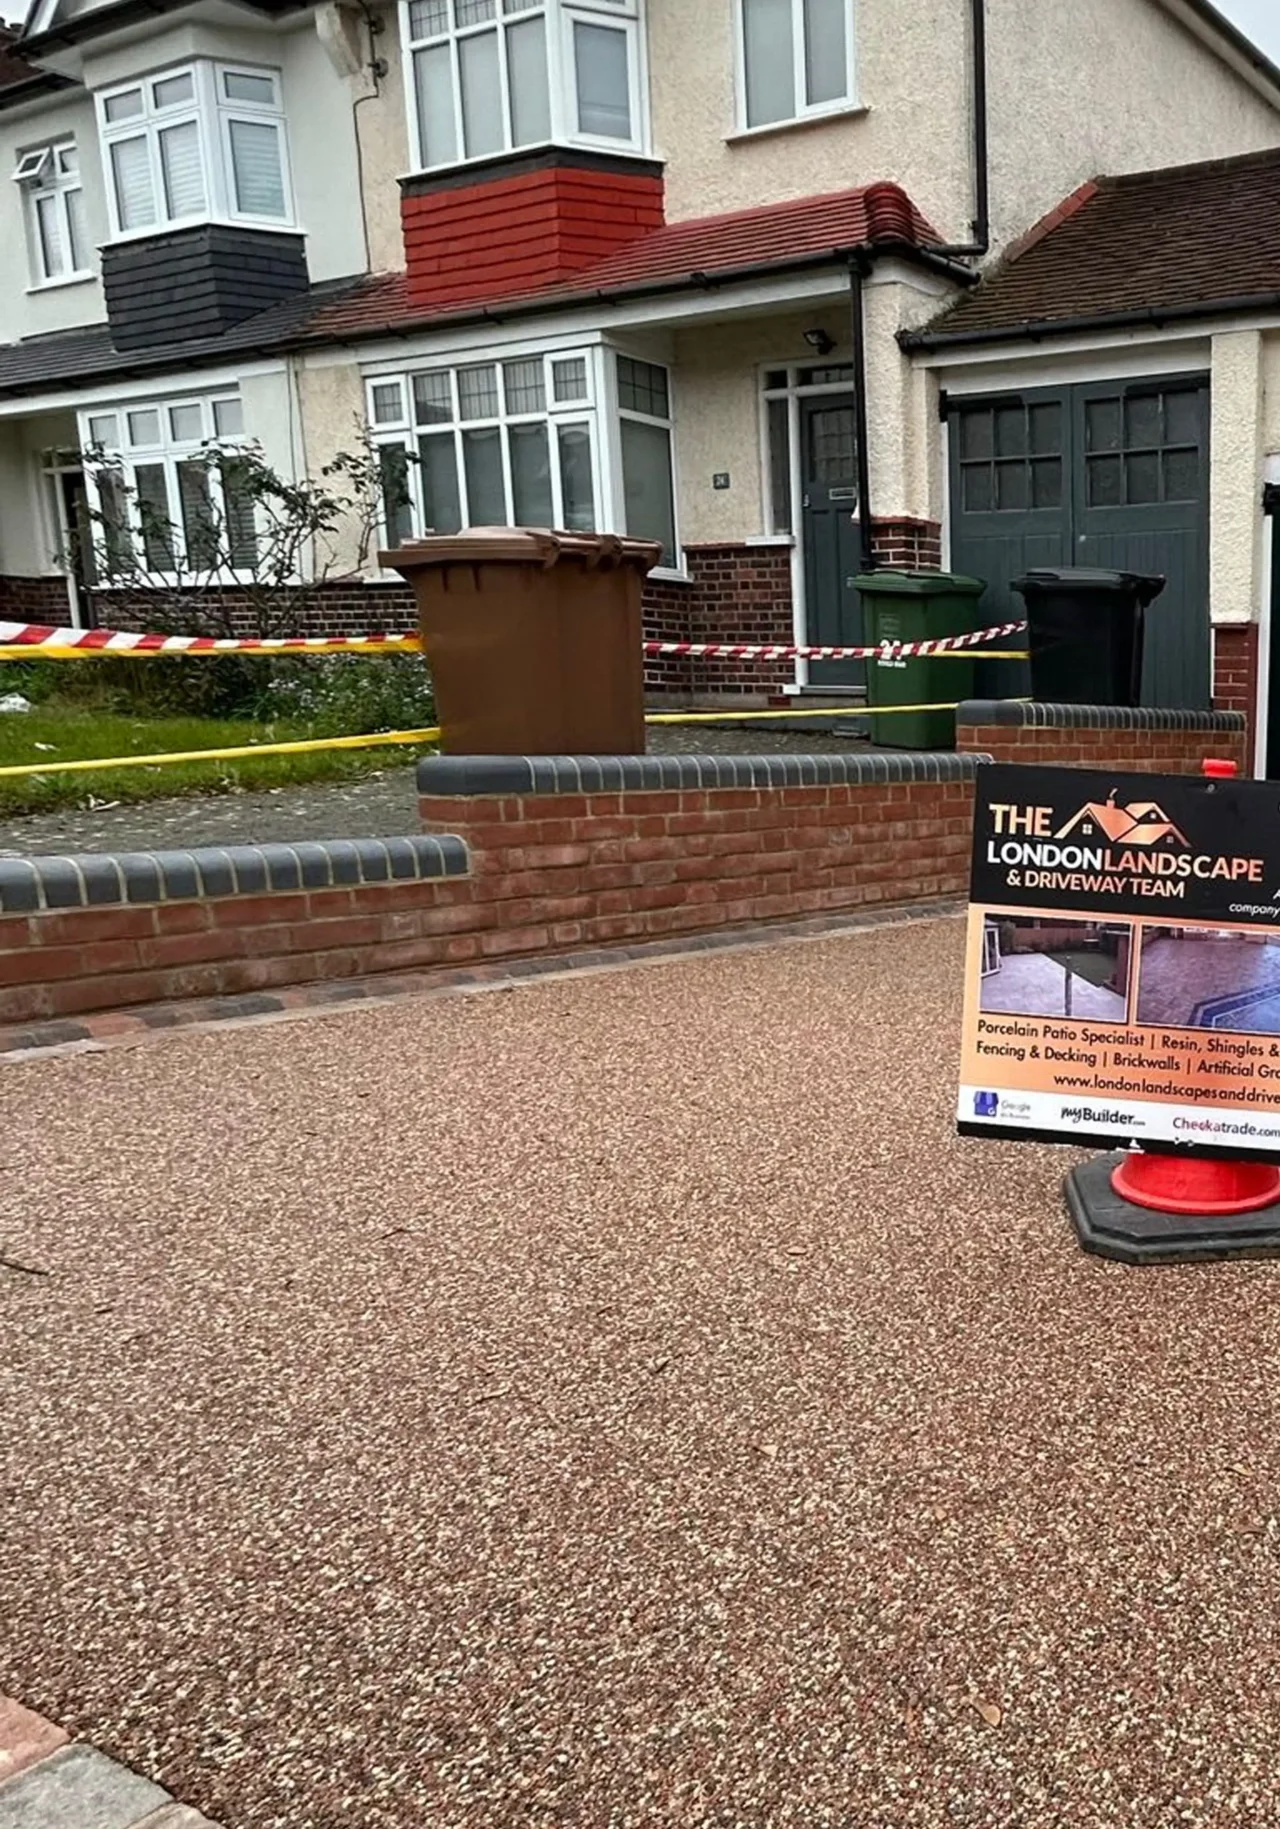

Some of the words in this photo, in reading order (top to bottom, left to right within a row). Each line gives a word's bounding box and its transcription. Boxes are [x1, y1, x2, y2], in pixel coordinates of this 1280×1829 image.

[988, 803, 1053, 837] THE
[1006, 869, 1022, 887] &
[1025, 871, 1126, 894] DRIVEWAY
[1130, 878, 1185, 899] TEAM
[1229, 902, 1280, 918] company
[978, 1020, 1038, 1037] Porcelain
[1043, 1026, 1077, 1041] Patio
[1081, 1030, 1145, 1047] Specialist
[1162, 1036, 1203, 1054] Resin,
[1207, 1038, 1264, 1057] Shingles
[1269, 1044, 1280, 1056] &
[976, 1041, 1026, 1061] Fencing
[1029, 1047, 1040, 1059] &
[1044, 1049, 1097, 1067] Decking
[1113, 1054, 1181, 1071] Brickwalls
[1197, 1059, 1254, 1077] Artificial
[1172, 1116, 1280, 1138] Checkatrade.com
